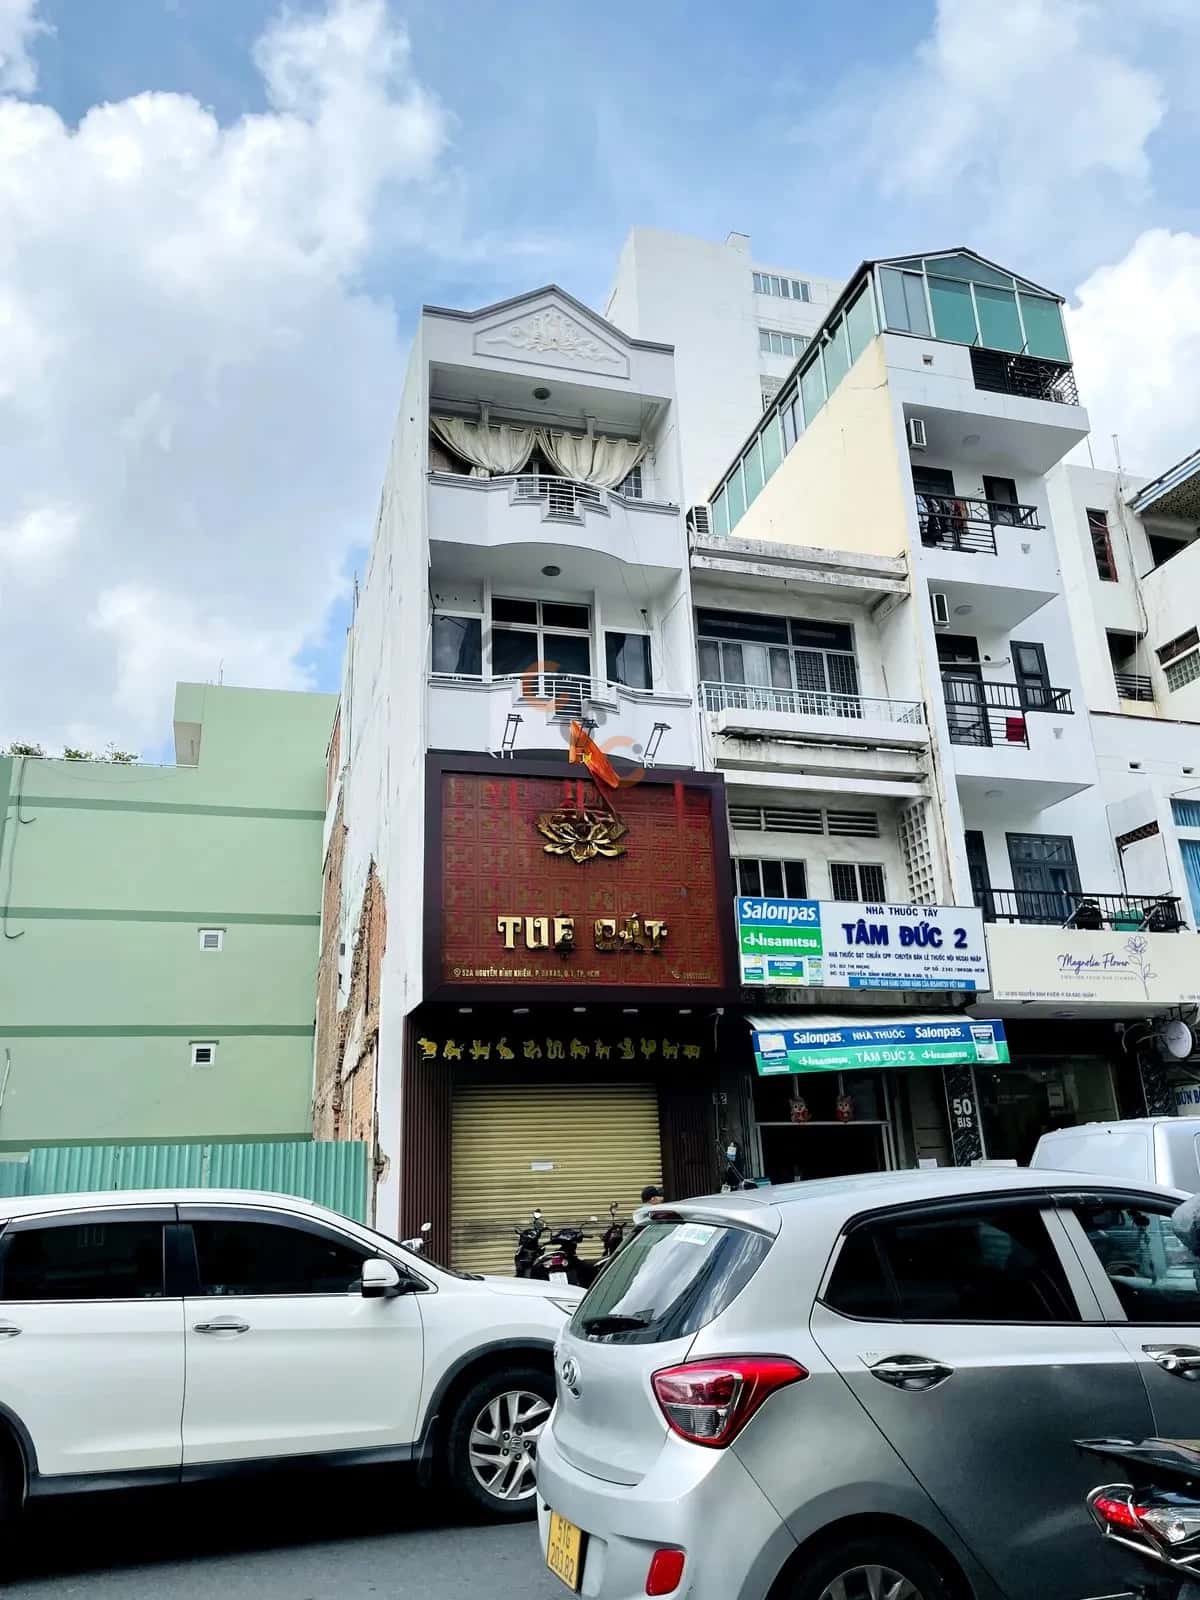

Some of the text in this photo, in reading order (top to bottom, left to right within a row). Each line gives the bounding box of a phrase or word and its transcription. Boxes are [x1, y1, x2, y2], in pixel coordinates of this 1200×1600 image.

[742, 901, 816, 923] Salonpas
[865, 905, 938, 918] NHÀ THUỐC TÂY
[841, 918, 968, 948] TÂM ĐỨC 2
[1057, 952, 1130, 975] Magnolia Flower
[793, 1031, 842, 1045] Salonpas
[852, 1030, 873, 1041] NHÀ
[915, 1026, 962, 1040] Salonpas
[907, 1050, 916, 1061] 2
[953, 1098, 972, 1115] 50
[957, 1118, 972, 1128] BIS
